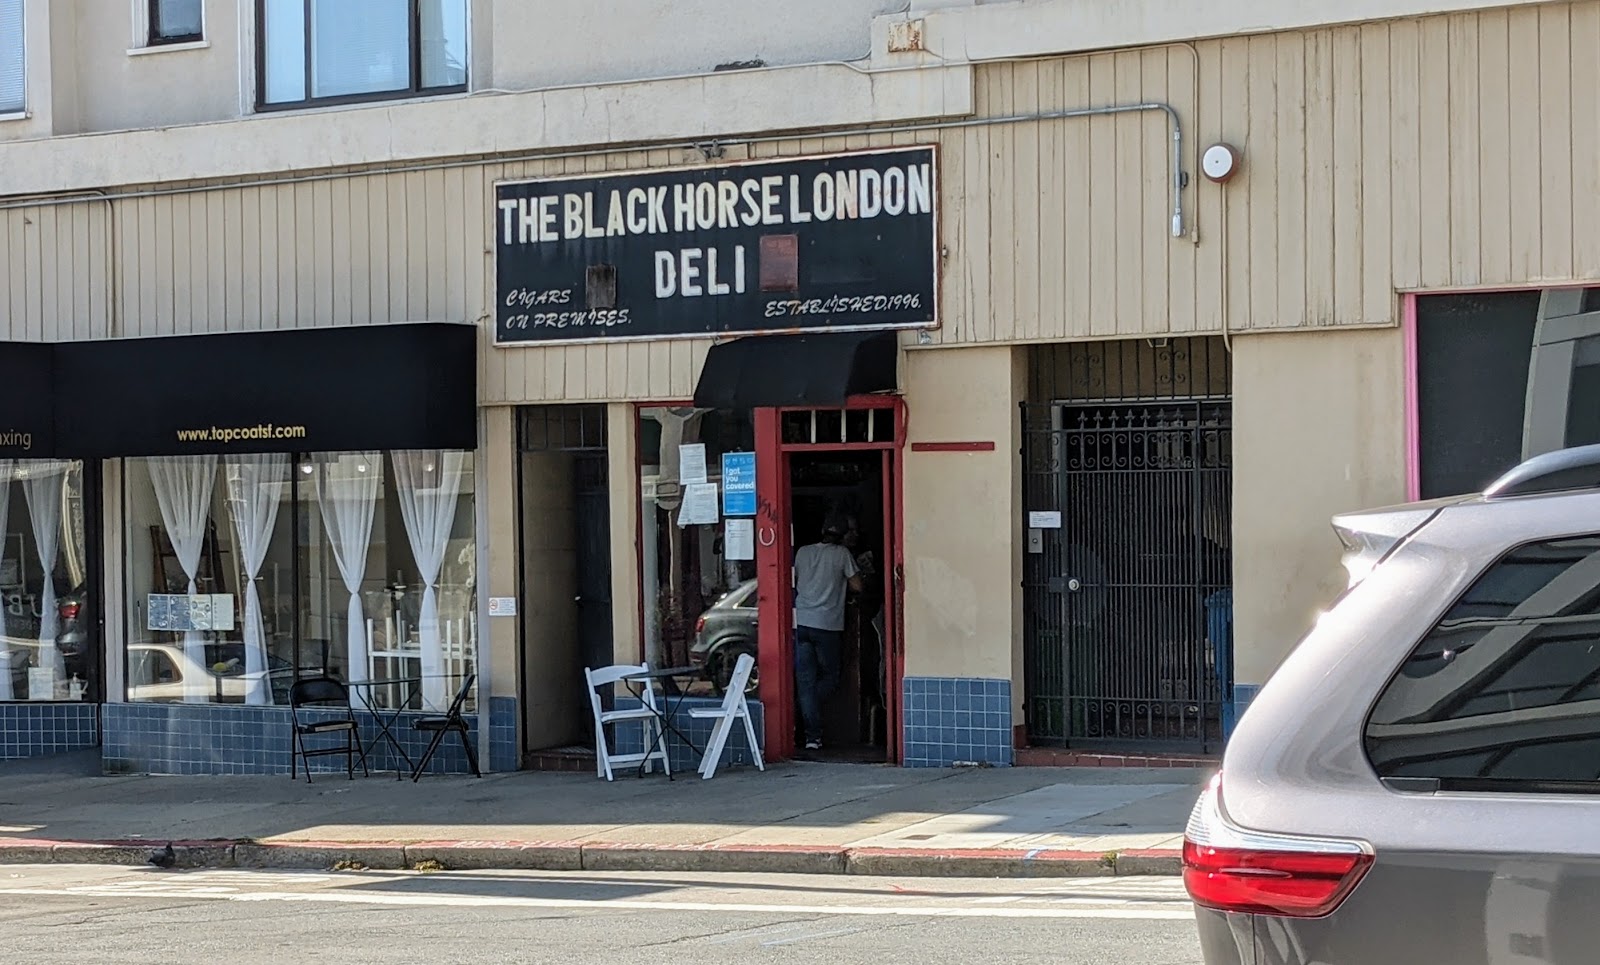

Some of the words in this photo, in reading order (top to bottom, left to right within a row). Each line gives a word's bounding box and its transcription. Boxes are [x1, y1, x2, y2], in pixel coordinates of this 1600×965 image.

[499, 194, 559, 246] THE
[564, 185, 669, 241] BLACK
[674, 174, 785, 233] HORSE
[790, 163, 931, 223] LONDON
[655, 244, 746, 299] DELI
[505, 287, 572, 309] CIGARS
[505, 313, 530, 330] ON
[176, 423, 306, 443] www.topcoatsf.com
[725, 475, 739, 484] you
[725, 481, 754, 490] covered
